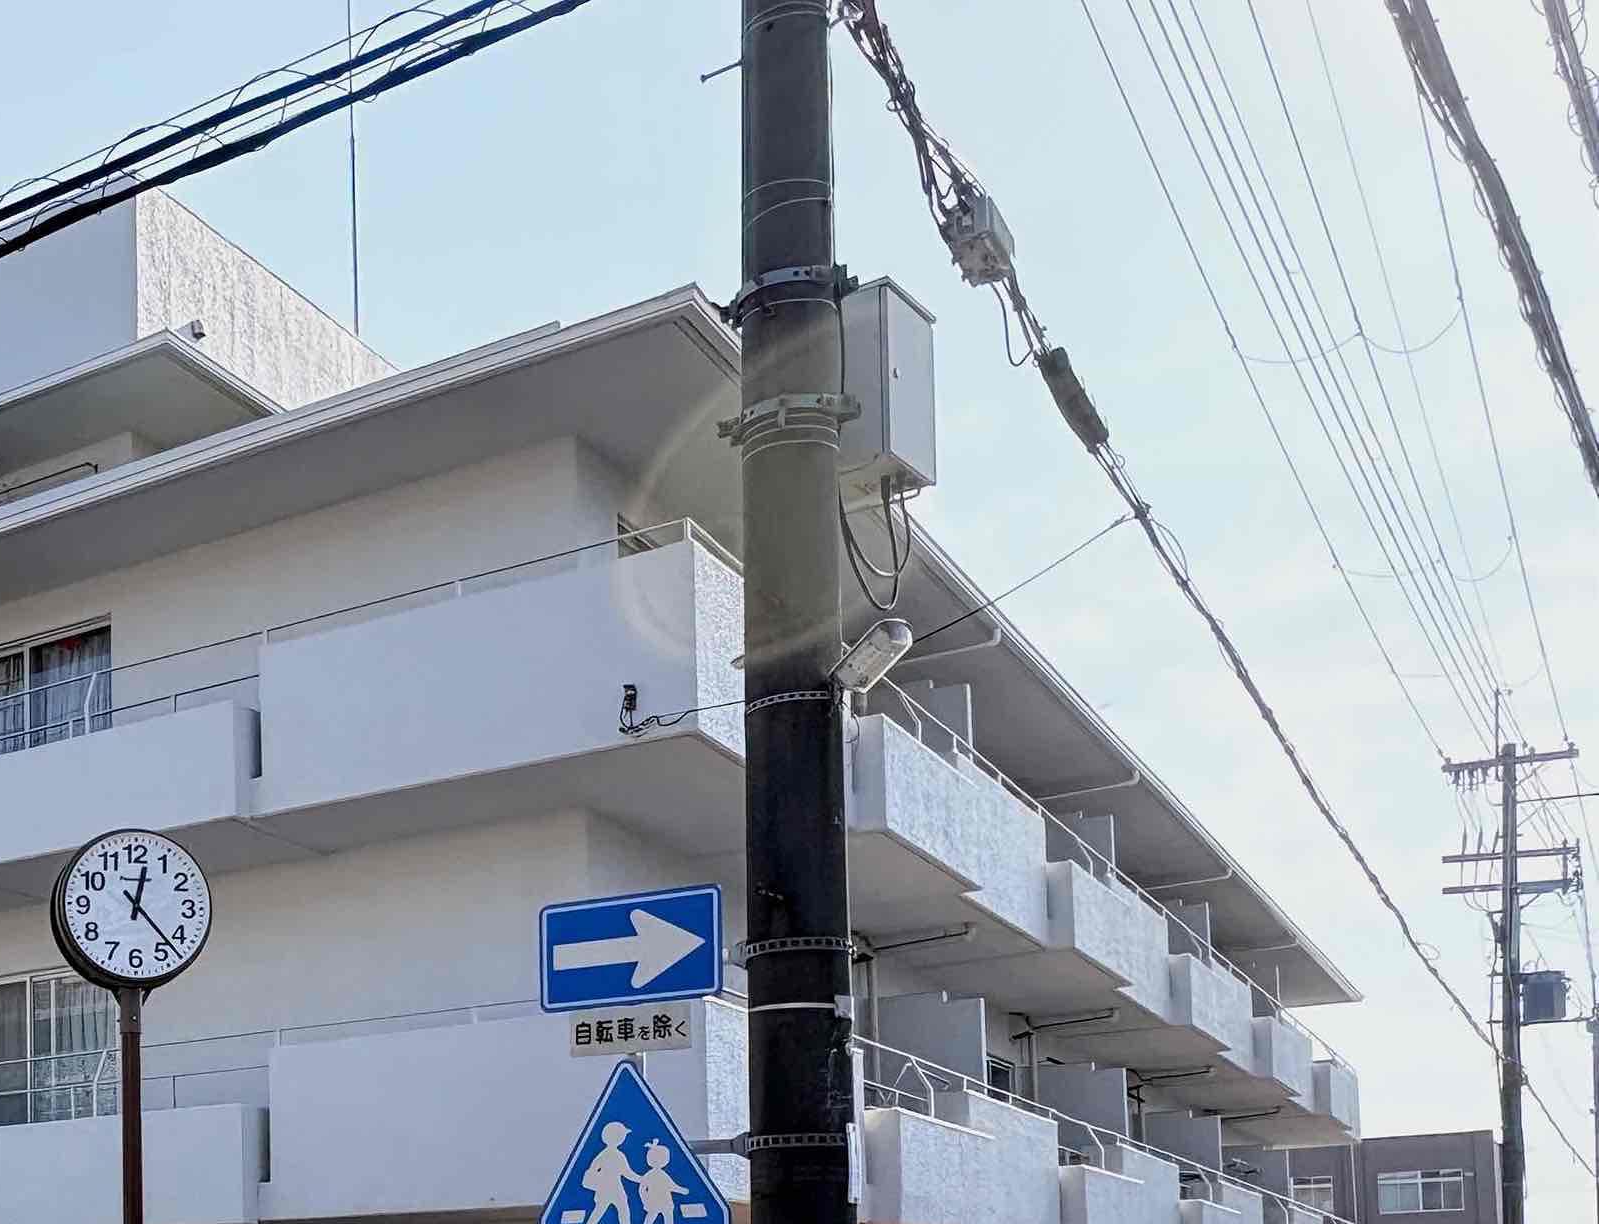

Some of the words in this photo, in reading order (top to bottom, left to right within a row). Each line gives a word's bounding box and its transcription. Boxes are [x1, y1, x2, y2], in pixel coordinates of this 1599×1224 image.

[98, 851, 119, 871] 11
[122, 844, 148, 864] 12
[157, 854, 168, 874] 1
[81, 870, 105, 891] 10
[173, 872, 189, 892] 2
[76, 895, 90, 914] 9
[181, 899, 196, 919] 3
[84, 922, 99, 941] 8
[171, 925, 187, 945] 4
[104, 941, 120, 960] 7
[128, 949, 143, 968] 6
[153, 942, 170, 962] 5
[576, 1014, 687, 1045] 自転車を除く
